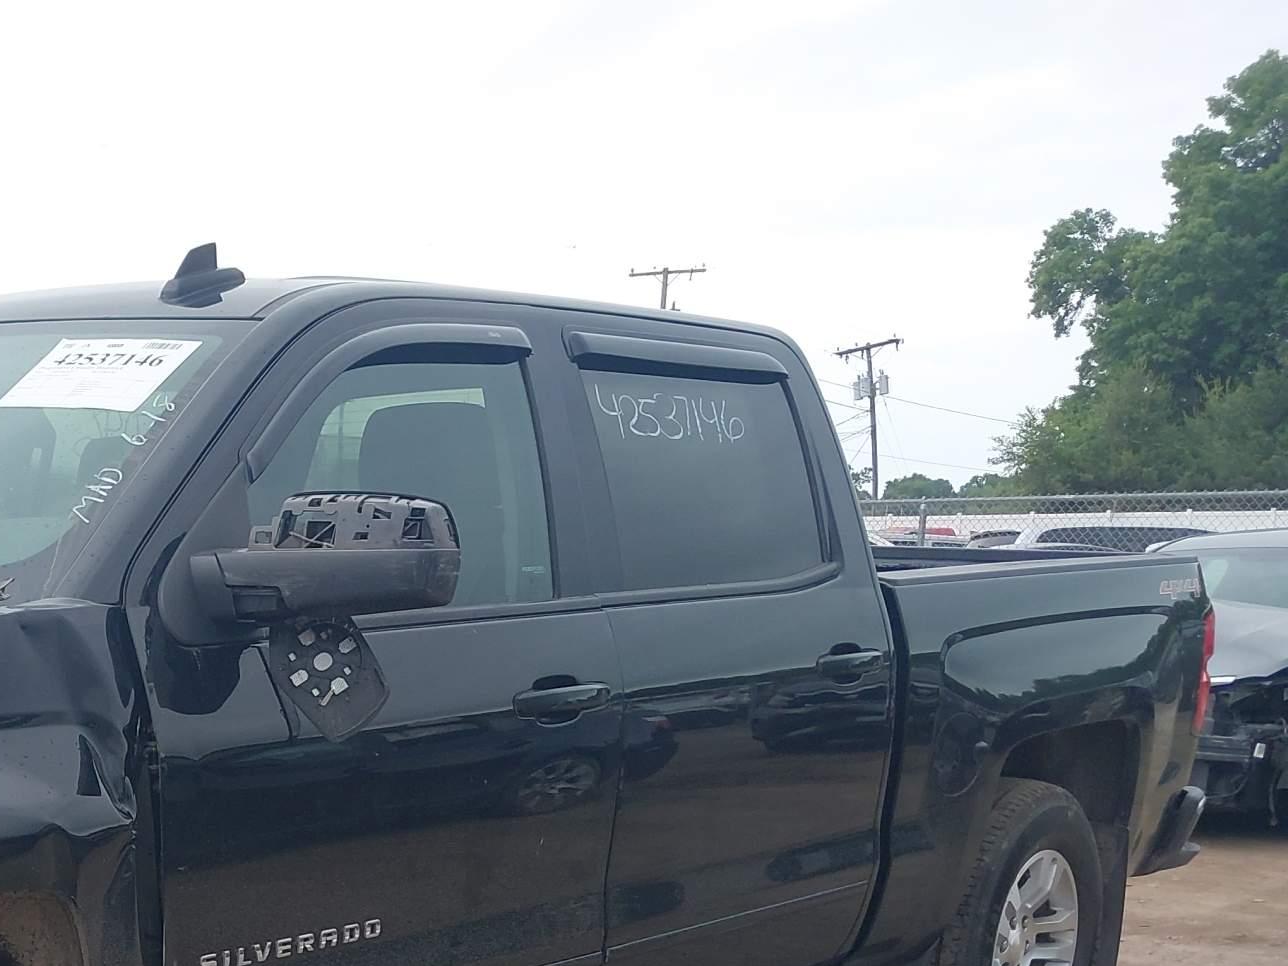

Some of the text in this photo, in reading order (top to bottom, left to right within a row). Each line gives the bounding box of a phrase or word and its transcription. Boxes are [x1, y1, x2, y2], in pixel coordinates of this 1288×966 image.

[54, 352, 166, 367] 42537146
[594, 383, 745, 444] 42537146
[68, 467, 123, 524] MAD
